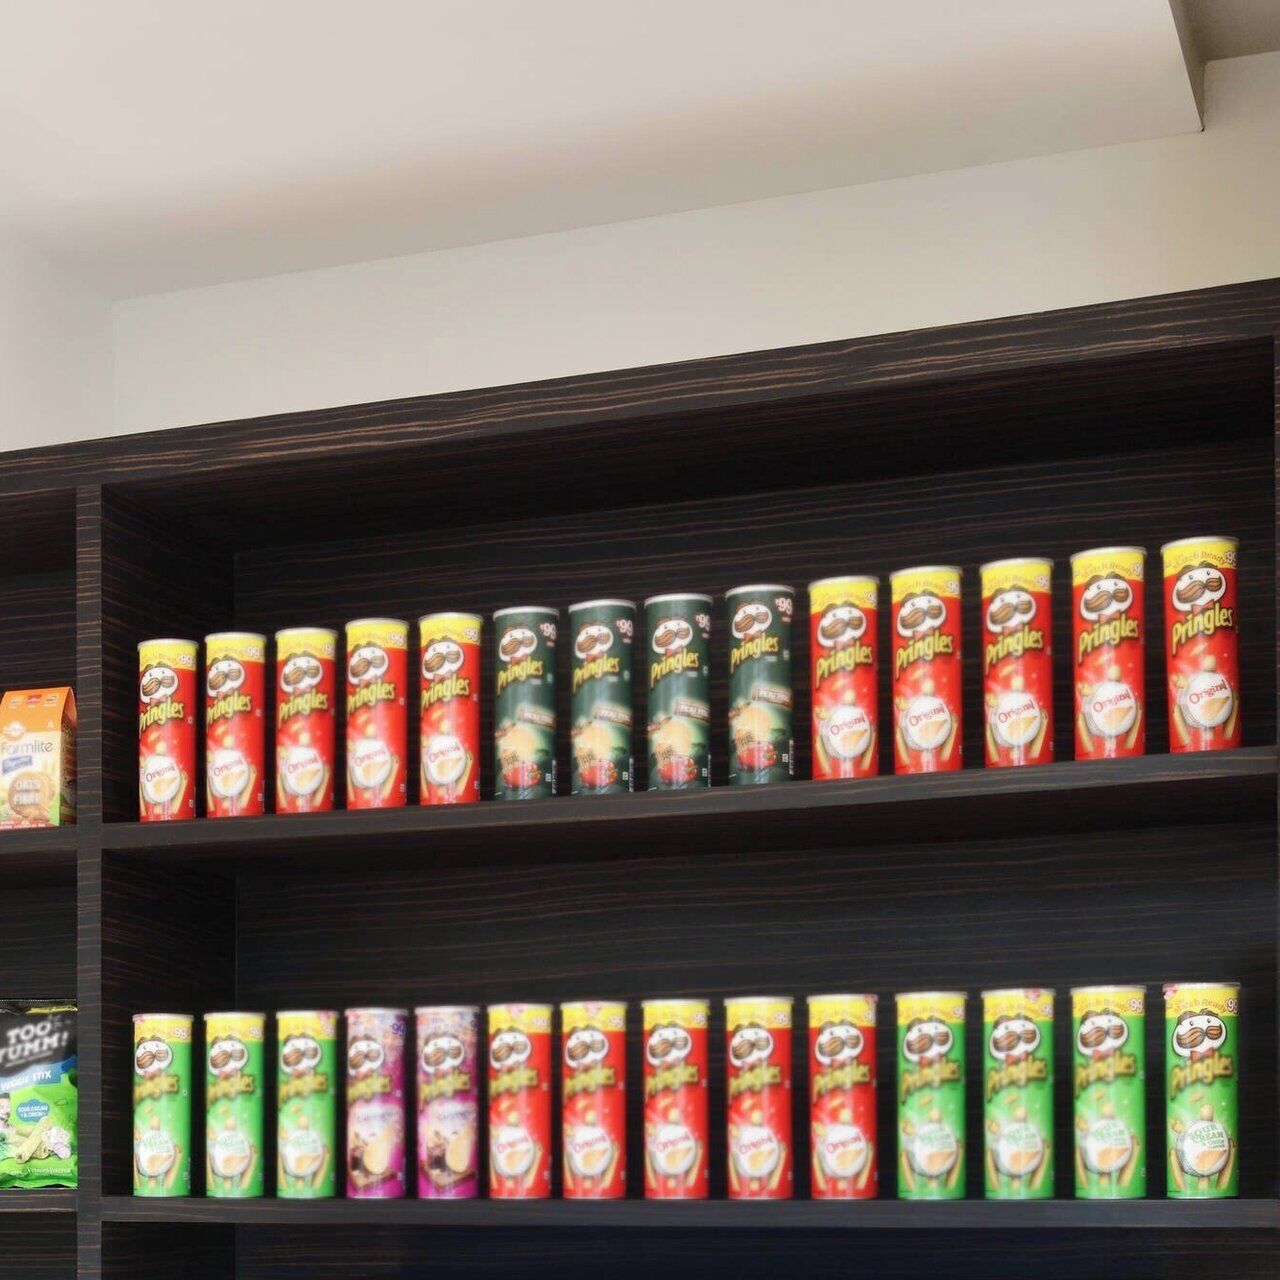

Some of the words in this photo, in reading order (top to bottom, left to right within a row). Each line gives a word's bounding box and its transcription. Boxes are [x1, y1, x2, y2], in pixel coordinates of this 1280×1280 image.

[1078, 612, 1139, 665] Pringles
[1172, 600, 1234, 657] Pringles
[730, 632, 780, 673] Pringles
[895, 630, 953, 681] Pringles
[985, 626, 1044, 677] Pringles
[497, 655, 544, 695] Pringles
[573, 651, 620, 694] Pringles
[650, 648, 700, 689] Pringles
[815, 640, 873, 690] Pringles
[1093, 688, 1130, 713] Original
[1189, 679, 1228, 704] Original
[278, 686, 329, 726] Pringles
[908, 703, 946, 727] Original
[997, 700, 1036, 724] Original
[829, 713, 866, 737] Original
[2, 740, 53, 755] Farmlite
[354, 747, 387, 769] Original
[428, 741, 462, 764] Original
[145, 764, 176, 783] Original
[213, 756, 244, 777] Original
[287, 755, 318, 774] Original
[6, 1020, 51, 1044] TOO
[0, 1078, 31, 1091] VEGGIE
[32, 1070, 52, 1083] STIX
